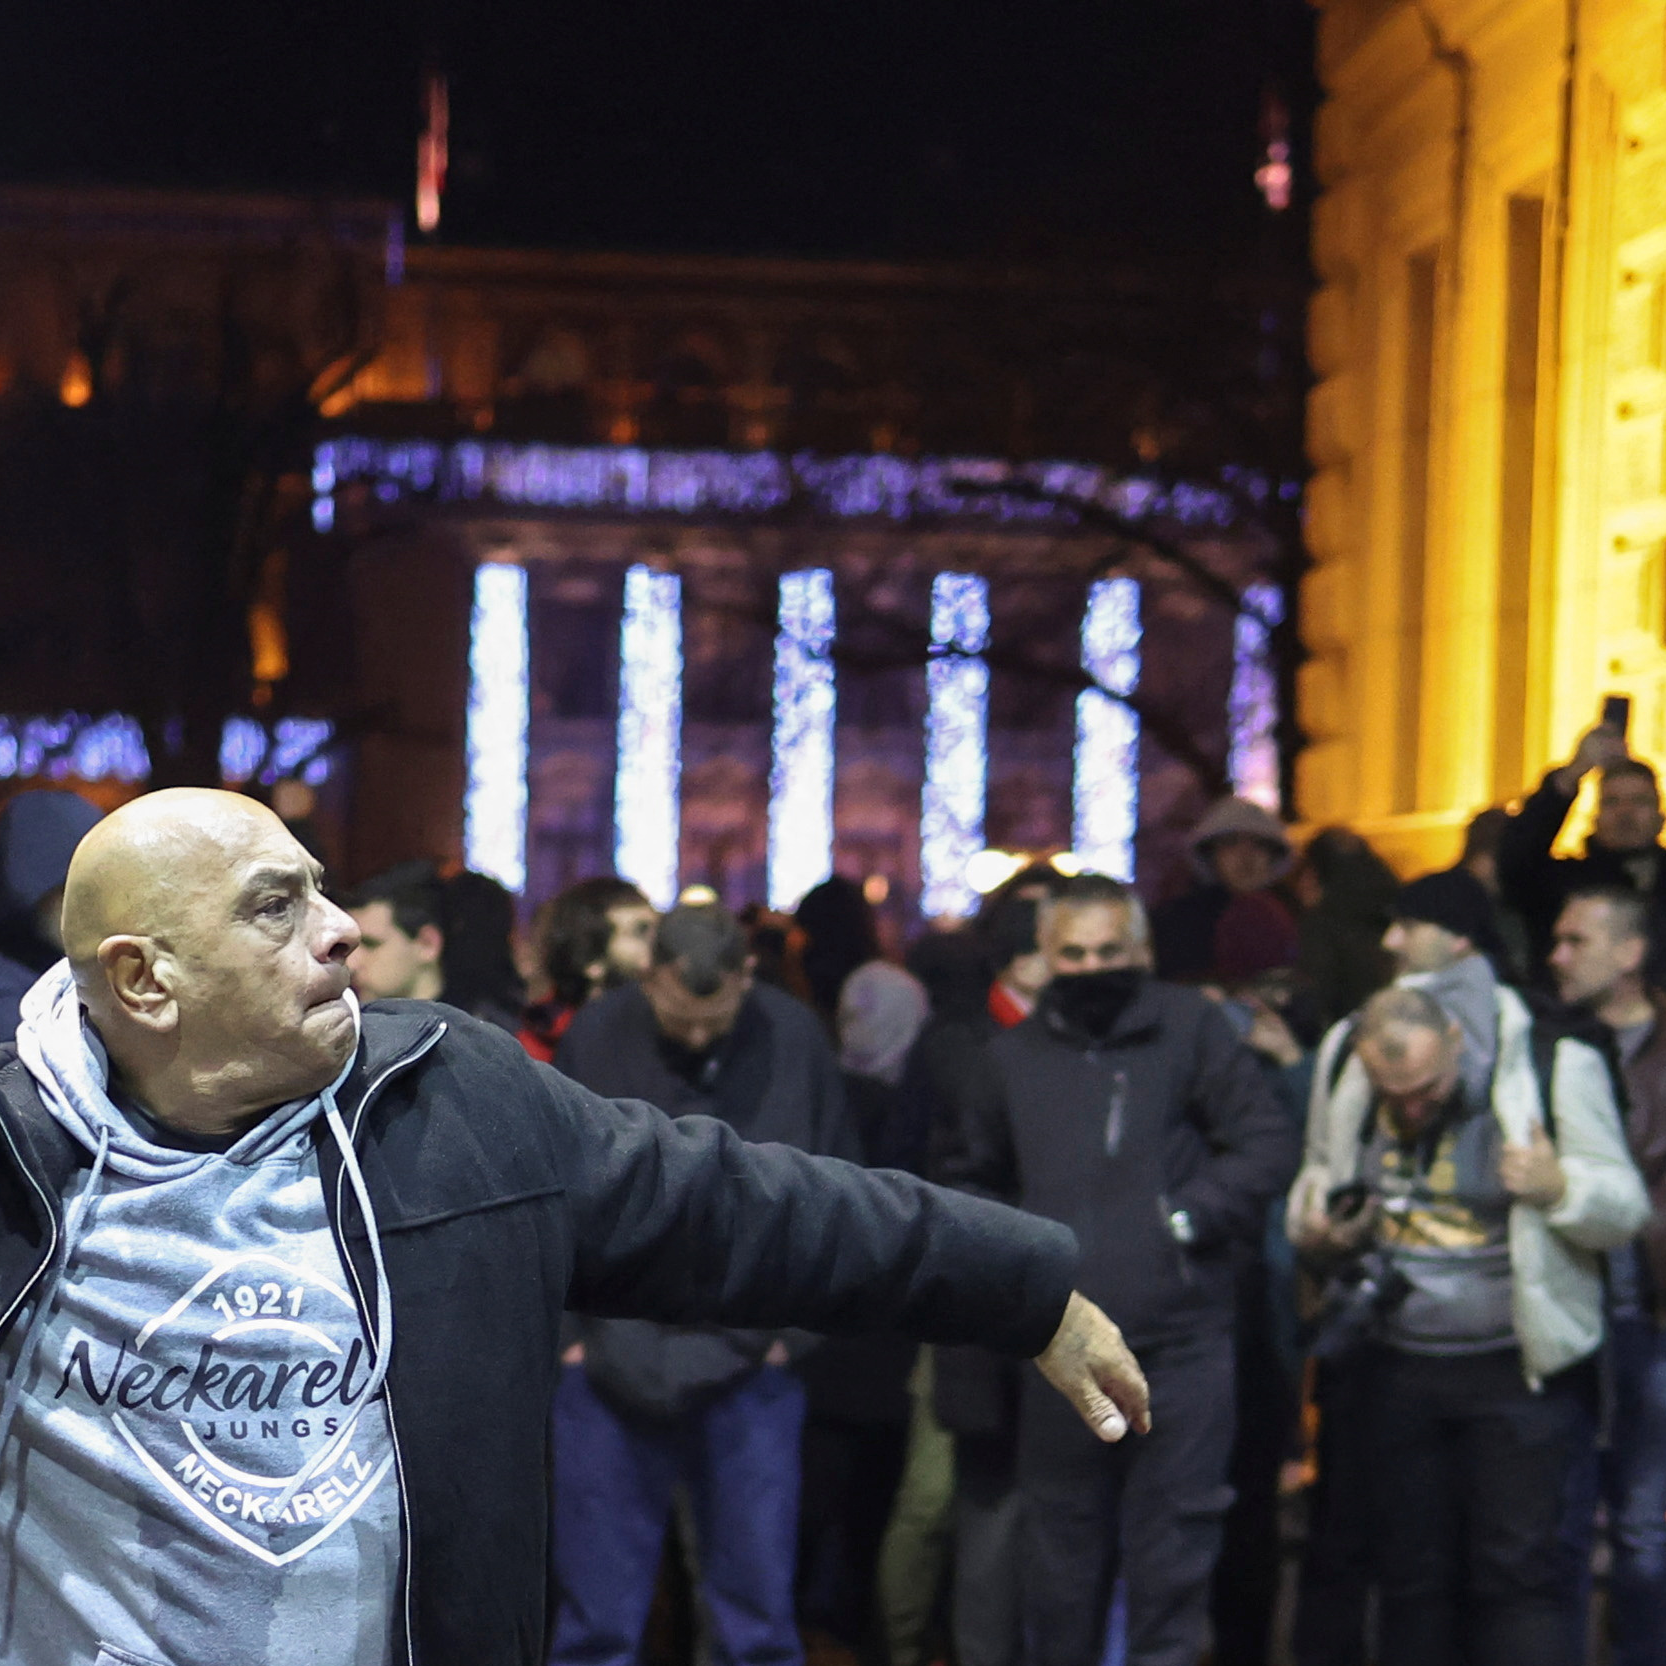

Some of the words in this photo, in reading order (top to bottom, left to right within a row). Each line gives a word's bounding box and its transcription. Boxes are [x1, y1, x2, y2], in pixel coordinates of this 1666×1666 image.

[213, 1282, 304, 1321] 1921
[55, 1337, 385, 1413] Neckarel
[203, 1417, 339, 1441] JUNGS
